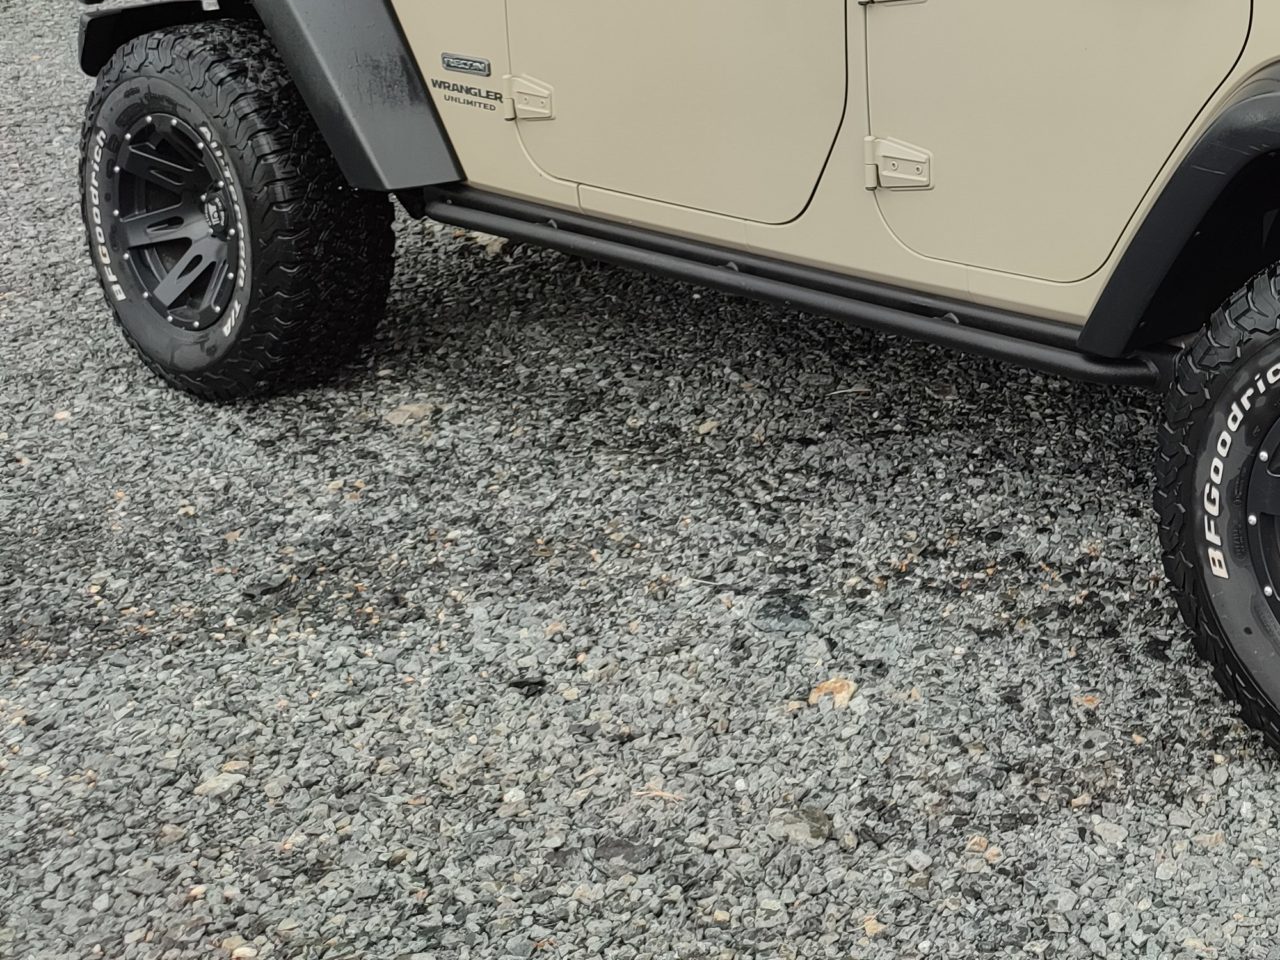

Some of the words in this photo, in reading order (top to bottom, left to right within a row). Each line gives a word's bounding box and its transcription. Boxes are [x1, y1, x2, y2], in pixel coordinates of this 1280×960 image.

[431, 78, 504, 104] WRANGLER
[444, 94, 496, 111] UNLIMITED
[90, 129, 127, 302] BFGoodrich
